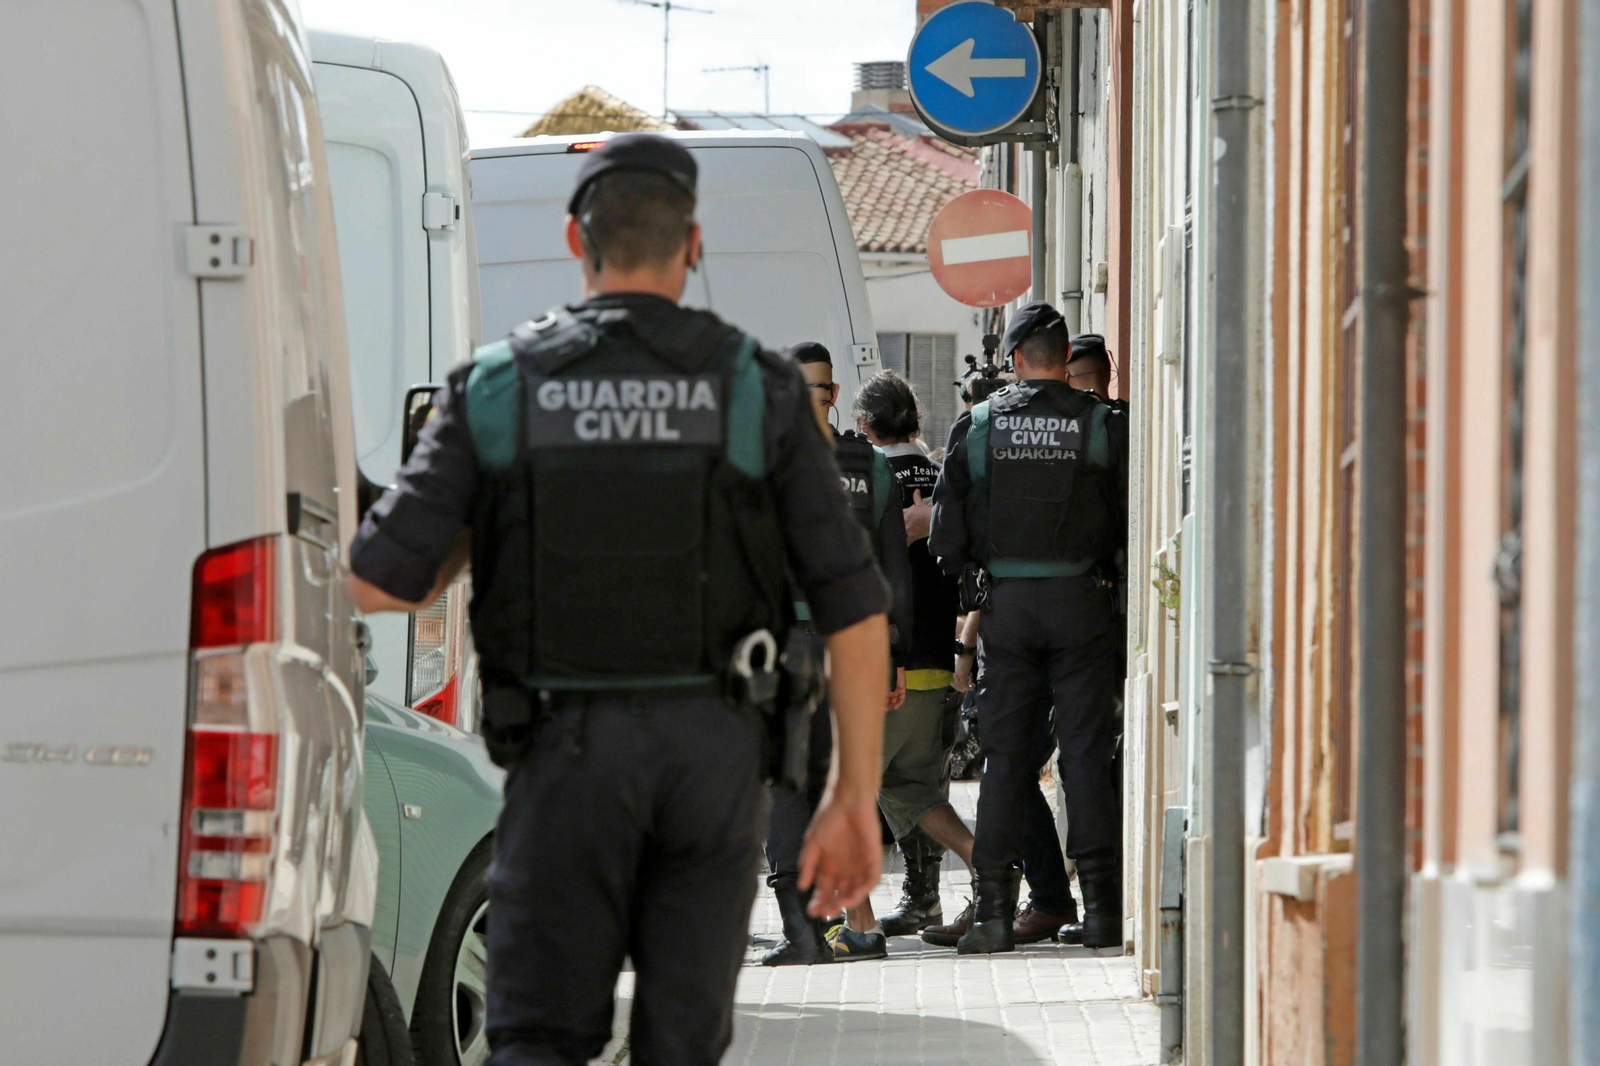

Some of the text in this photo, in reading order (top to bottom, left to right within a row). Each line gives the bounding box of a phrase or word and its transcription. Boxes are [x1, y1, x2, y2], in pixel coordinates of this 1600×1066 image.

[536, 379, 717, 411] GUARDIA
[574, 410, 681, 441] CIVIL
[994, 415, 1080, 433] GUARDIA
[1011, 430, 1061, 446] CIVIL
